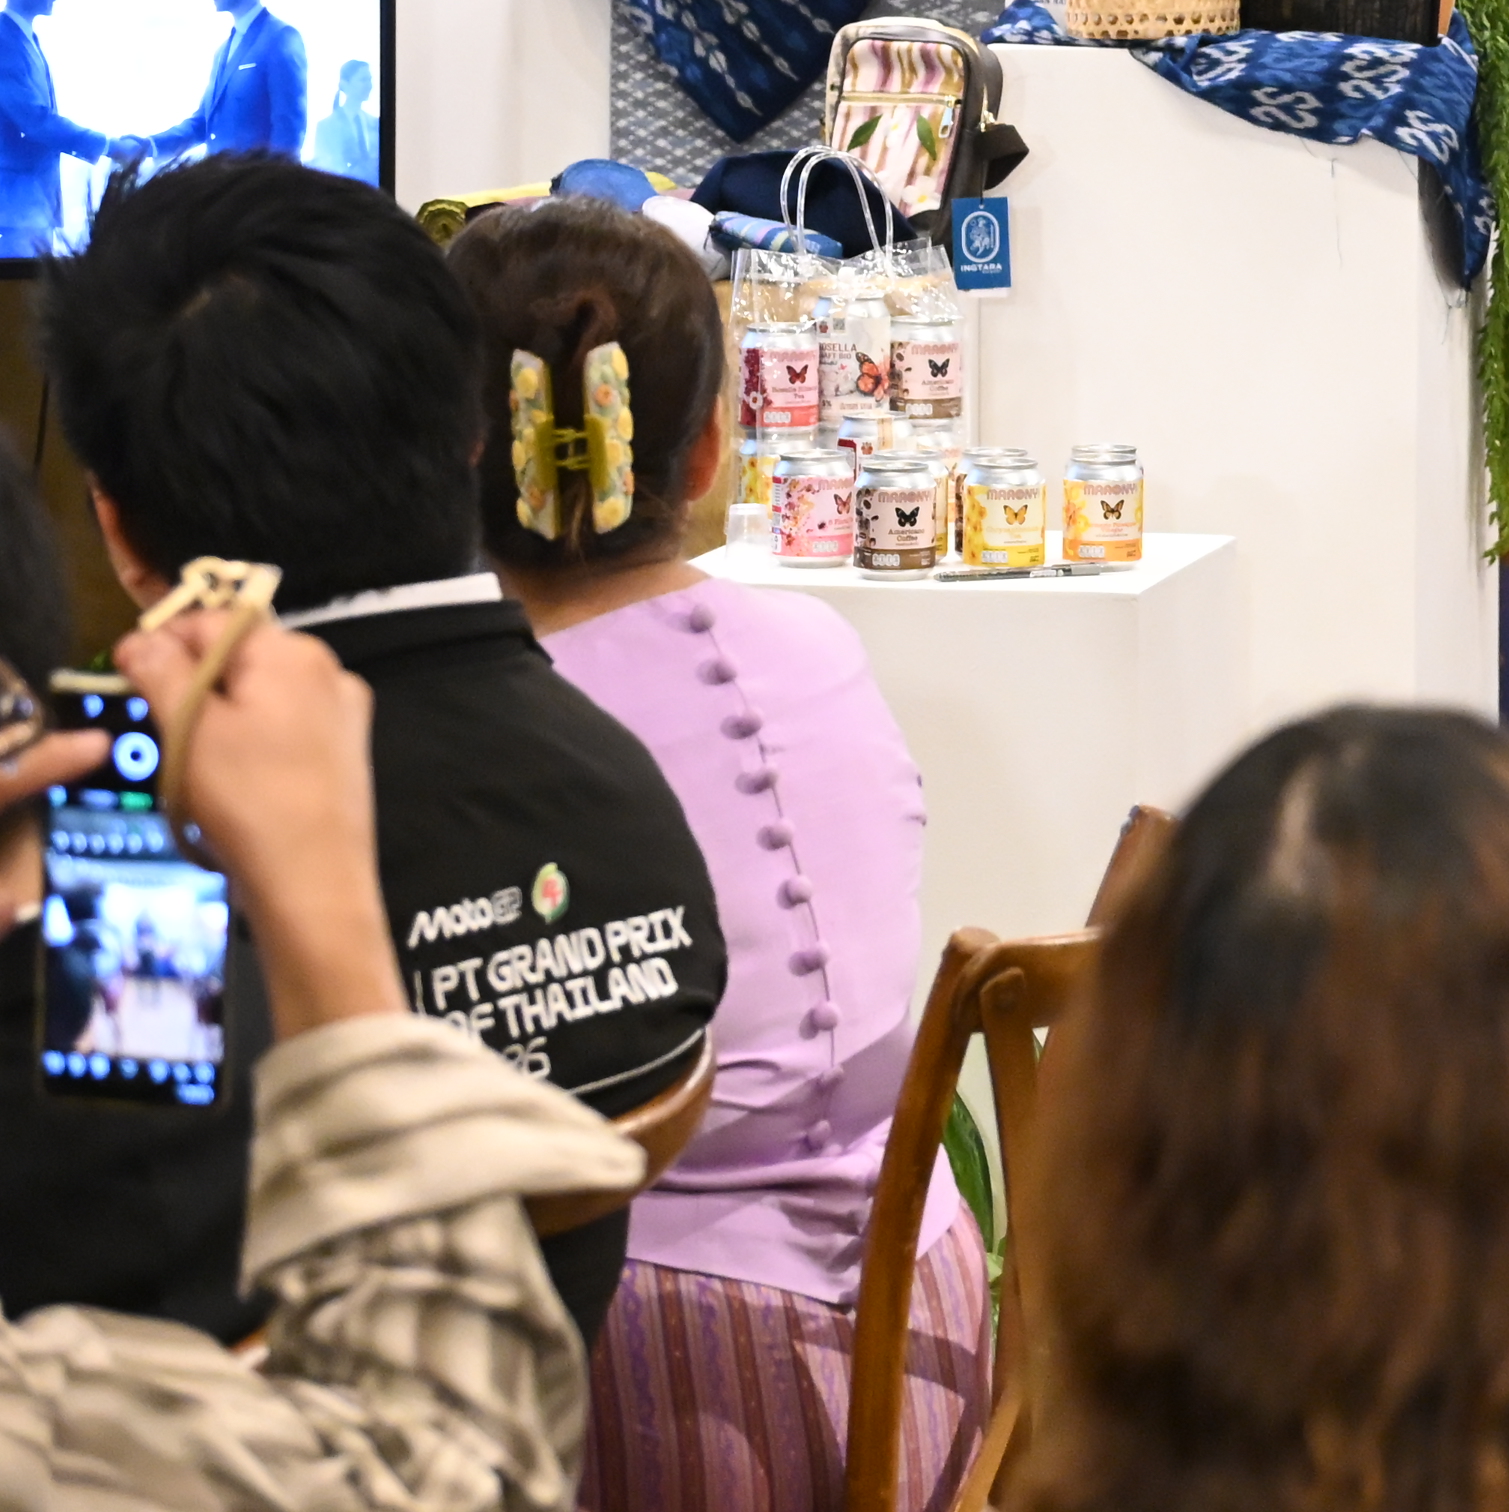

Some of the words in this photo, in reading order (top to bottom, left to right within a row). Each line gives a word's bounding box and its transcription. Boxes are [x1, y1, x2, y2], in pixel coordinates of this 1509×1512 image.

[960, 263, 1002, 273] INGTARA
[986, 488, 1038, 500] MARONY
[431, 957, 484, 1011] PT
[486, 927, 606, 993] GRAND
[603, 905, 693, 964] PRIX
[496, 956, 679, 1038] THAILAND
